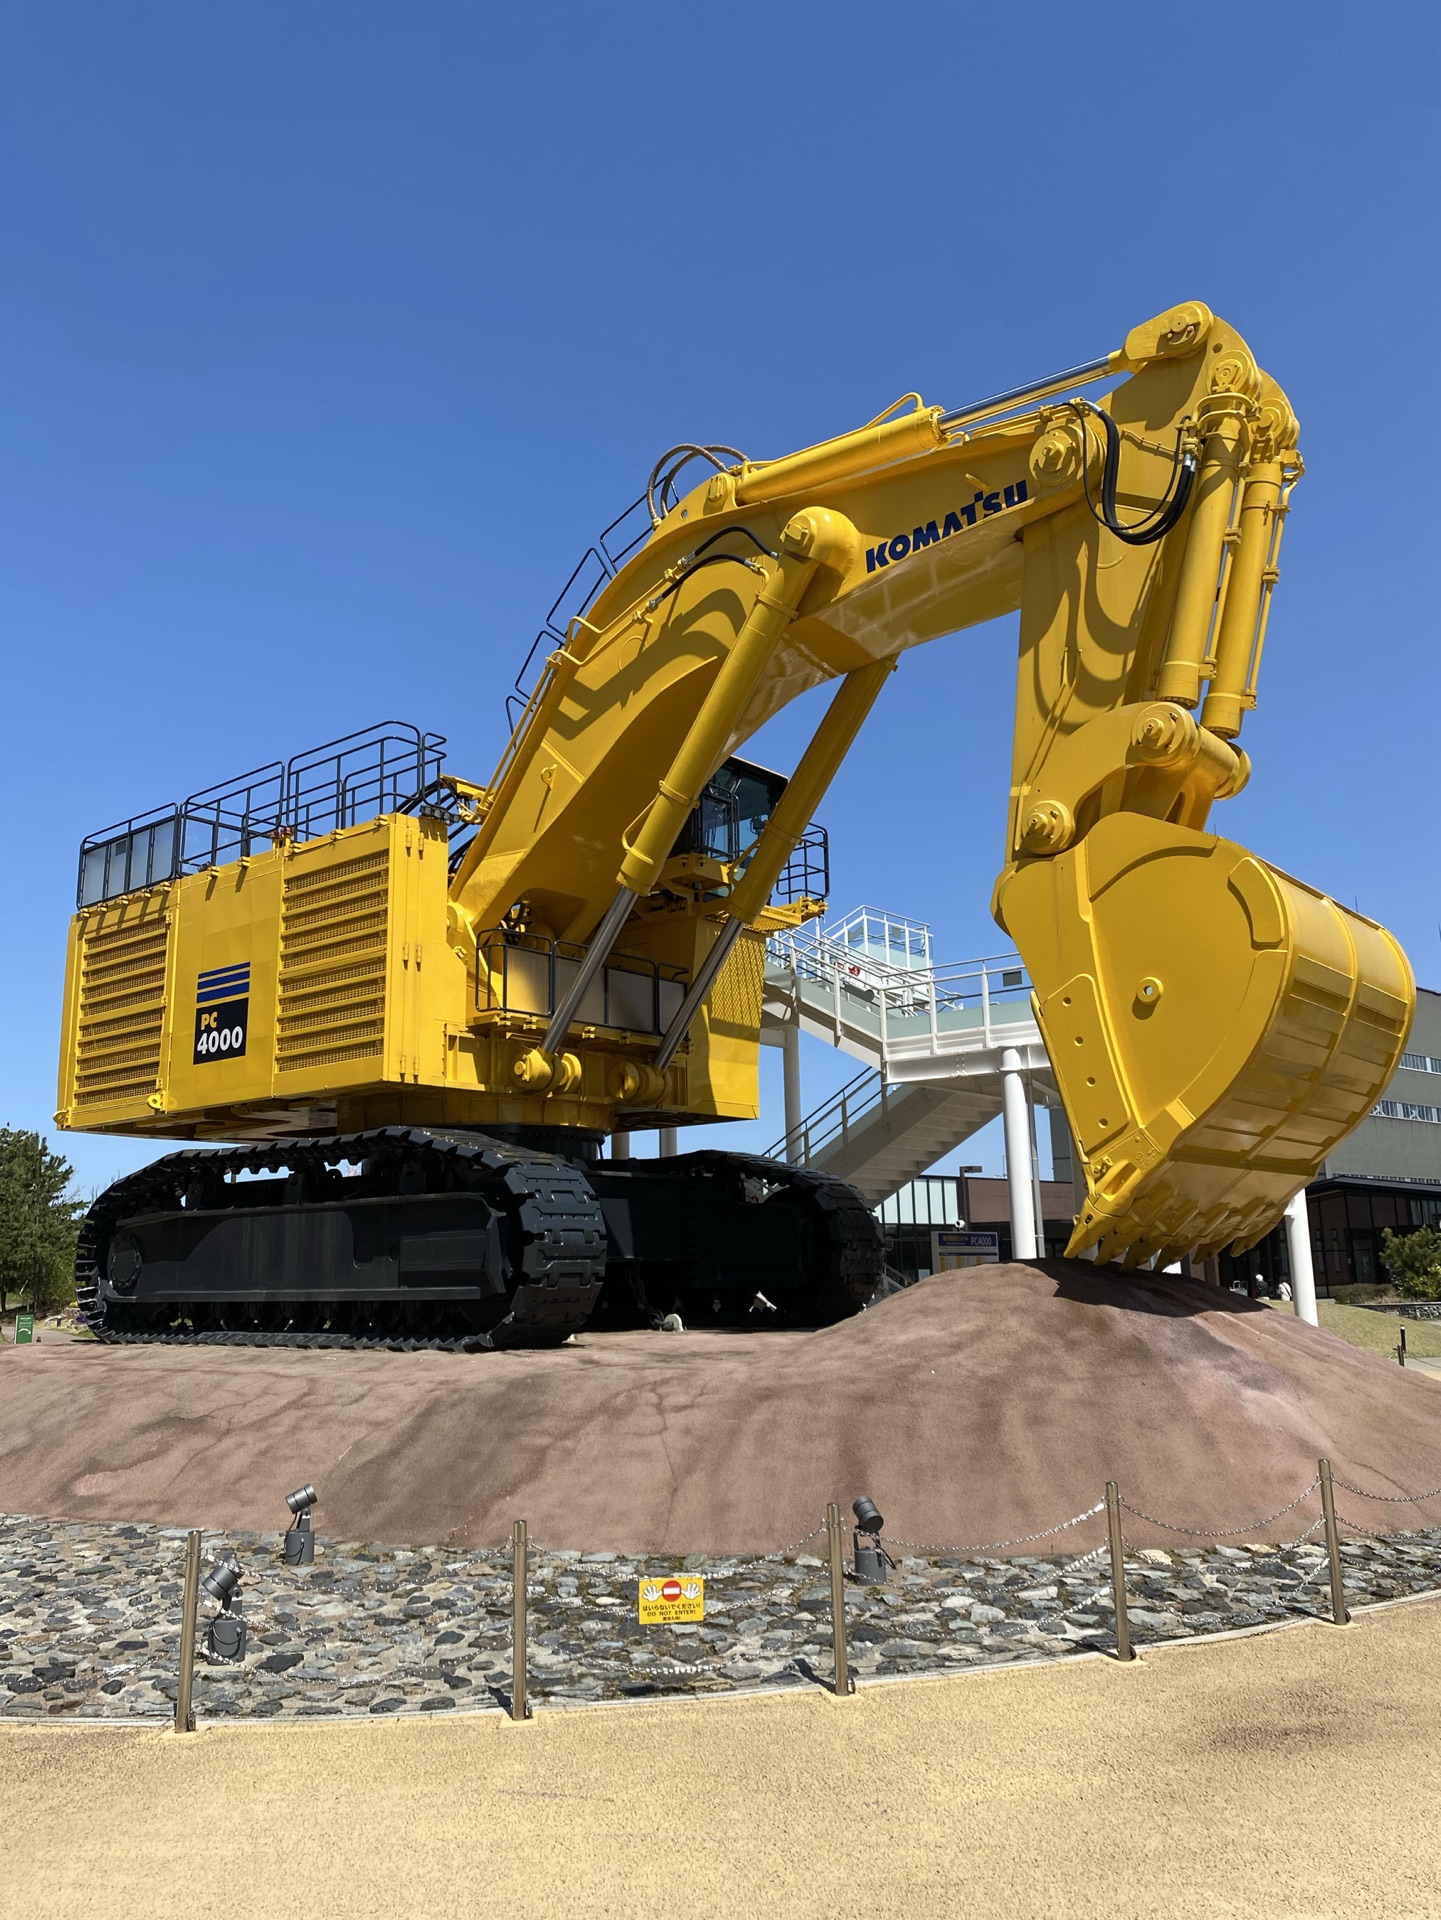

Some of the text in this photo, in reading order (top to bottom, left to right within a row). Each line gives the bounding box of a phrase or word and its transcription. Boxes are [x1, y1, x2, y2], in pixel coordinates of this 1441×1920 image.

[865, 479, 1029, 574] KOMATSU
[201, 1011, 218, 1030] PC
[197, 1026, 243, 1054] 4000
[970, 1236, 992, 1246] PC4000
